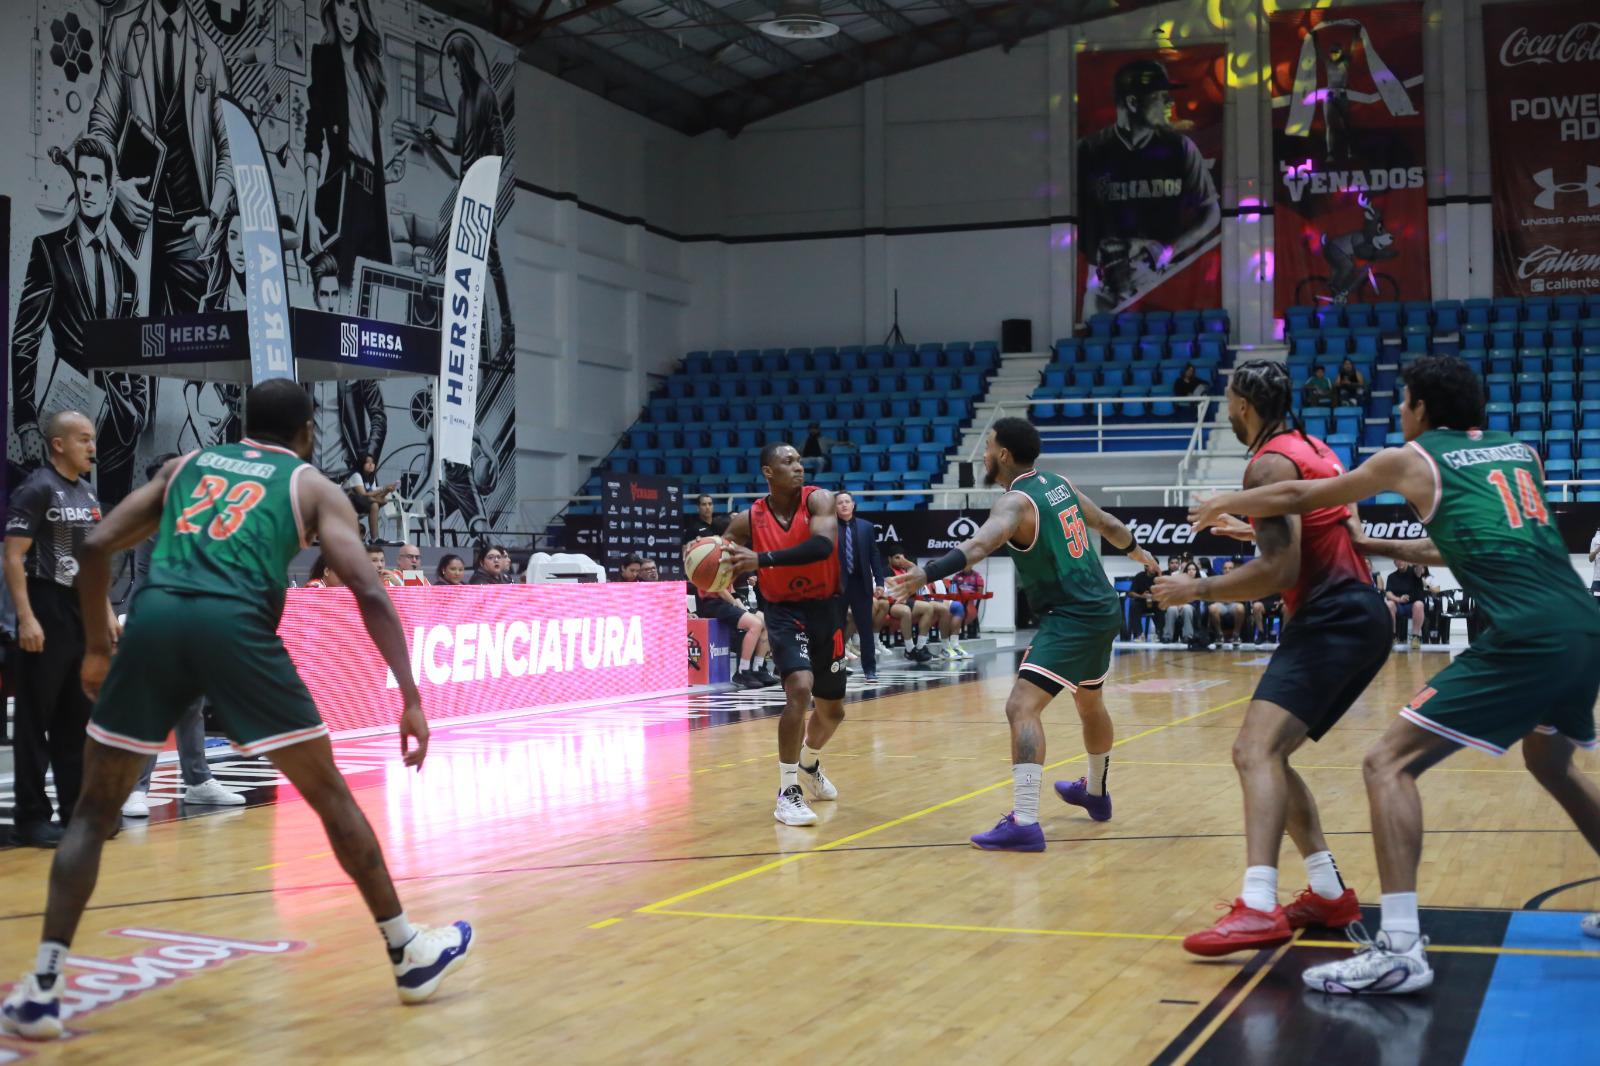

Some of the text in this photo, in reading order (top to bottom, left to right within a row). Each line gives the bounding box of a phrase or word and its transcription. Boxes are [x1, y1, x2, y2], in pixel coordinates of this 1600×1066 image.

[1500, 22, 1600, 67] Coca-Col
[1510, 93, 1600, 121] POWE
[1280, 160, 1424, 202] VENADOS
[1521, 216, 1565, 226] UNDER
[1518, 245, 1600, 279] Calien
[170, 325, 230, 343] HERSA
[361, 330, 403, 351] HERSA
[446, 267, 471, 405] HERSA
[1442, 443, 1533, 469] MARTINEZ
[174, 474, 266, 540] 23
[1045, 484, 1071, 507] ALLEN
[1486, 467, 1549, 529] 14
[46, 507, 102, 522] CIBACO
[927, 538, 961, 549] Banco
[1058, 504, 1089, 559] 55
[386, 615, 645, 689] ICENCIATURA
